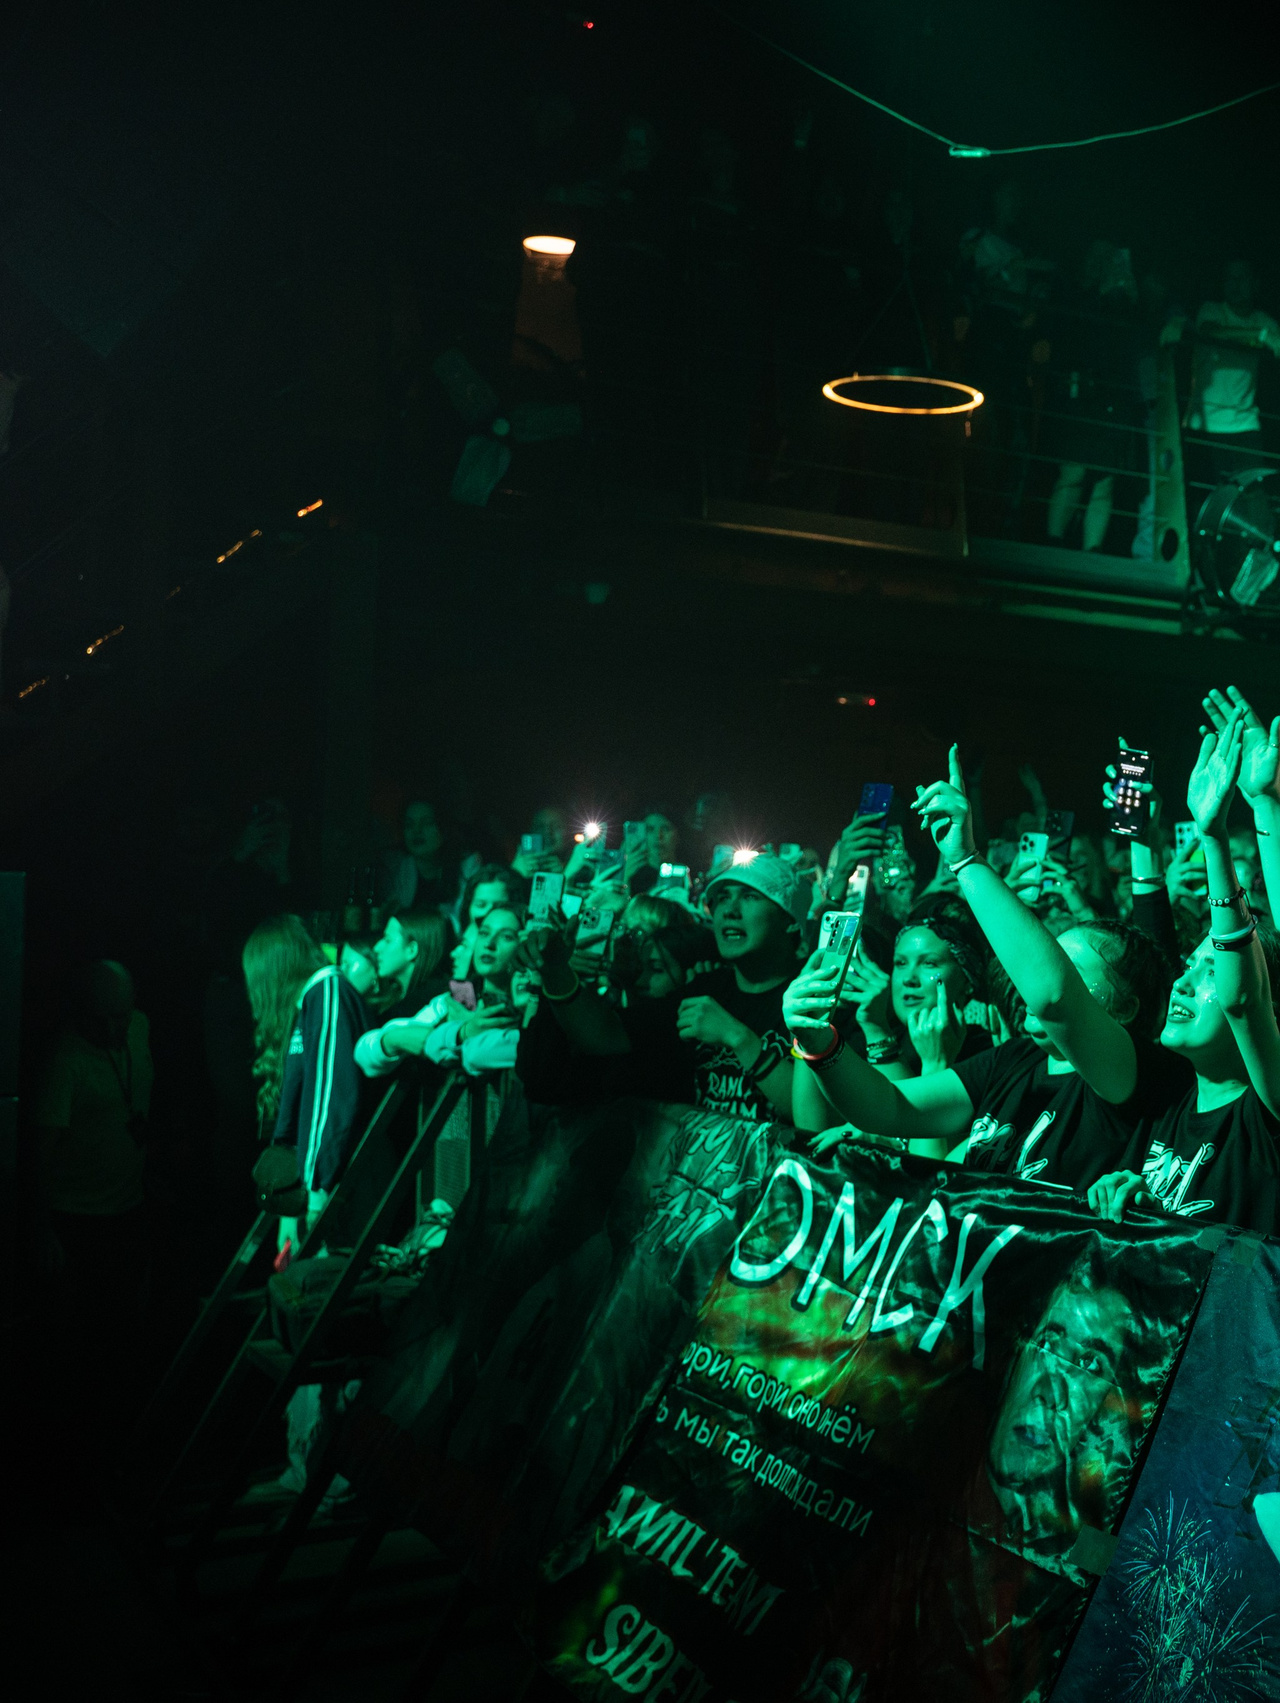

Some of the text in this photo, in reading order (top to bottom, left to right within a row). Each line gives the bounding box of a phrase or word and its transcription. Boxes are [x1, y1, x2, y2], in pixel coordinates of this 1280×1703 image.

[730, 1159, 1025, 1371] ОМСК
[674, 1407, 720, 1448] мы
[721, 1430, 763, 1473] так
